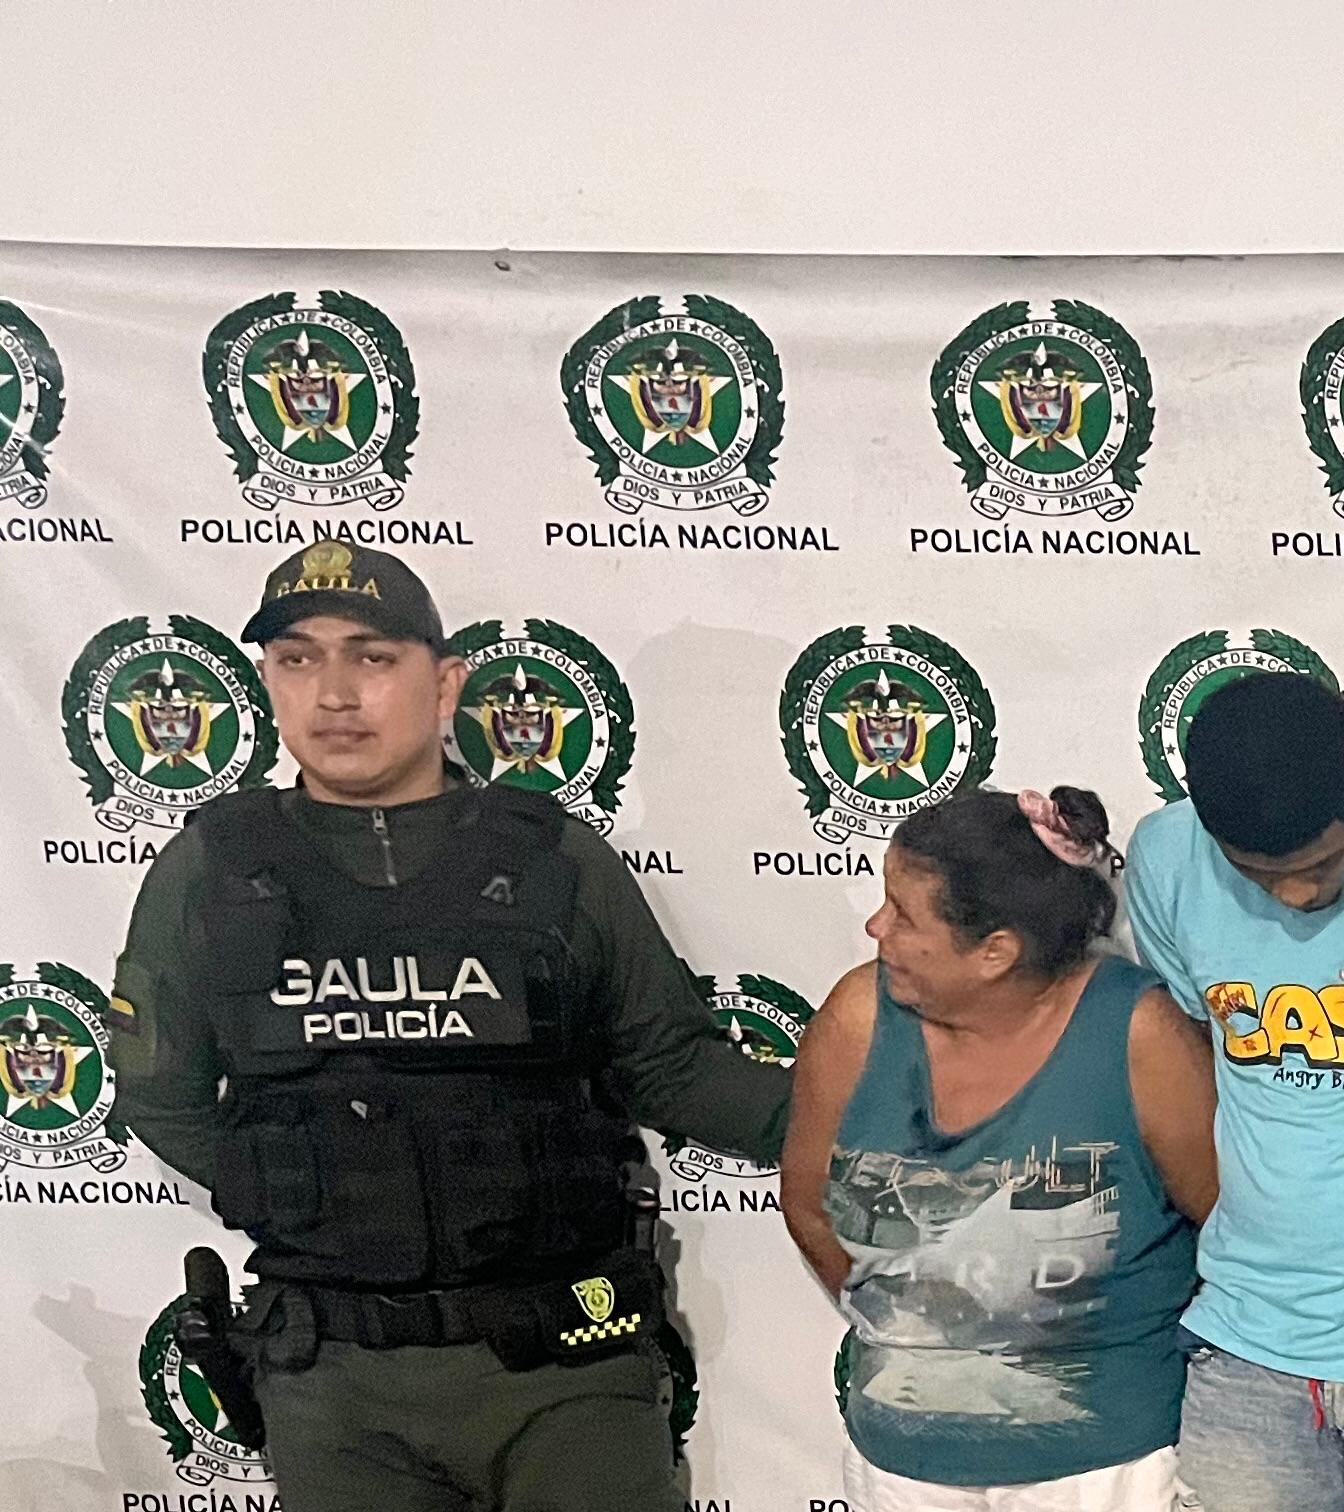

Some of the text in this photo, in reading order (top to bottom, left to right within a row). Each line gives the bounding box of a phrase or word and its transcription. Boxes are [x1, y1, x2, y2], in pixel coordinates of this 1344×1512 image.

[294, 310, 315, 322] DE
[331, 317, 387, 386] COLOMBIA
[1032, 323, 1053, 335] DE
[1069, 330, 1122, 394] COLOMBIA
[249, 435, 305, 478] POLICIA
[978, 443, 1034, 487] POLICIA
[261, 476, 385, 499] DIOS PATRIA
[990, 485, 1115, 510] DIOS Y PATRIA
[0, 518, 113, 542] CIONAL
[182, 514, 472, 544] POLICÍA NACIONAL
[545, 518, 839, 550] POLICÍA NACIONAL
[911, 524, 1200, 554] POLICÍA NACIONAL
[153, 640, 173, 649] DE
[189, 645, 248, 713] COLOMBIA
[507, 644, 605, 719] DE COLOMBIA
[870, 650, 890, 660] DE
[907, 655, 967, 725] COLOMBIA
[107, 760, 163, 802] POLICIA
[822, 771, 877, 813] POLICIA
[120, 800, 155, 820] DIOS
[832, 811, 867, 831] DIOS
[44, 836, 158, 865] POLICÍA
[754, 848, 874, 875] POLICÍA
[19, 986, 38, 995] DE
[303, 1003, 474, 1042] POLICÍA
[1273, 1067, 1325, 1090] Angry
[54, 1141, 108, 1162] PATRIA
[689, 1150, 724, 1169] DIOS
[40, 1182, 190, 1204] NACIONAL
[184, 1419, 238, 1457] POLICIA
[195, 1456, 230, 1474] DIOS
